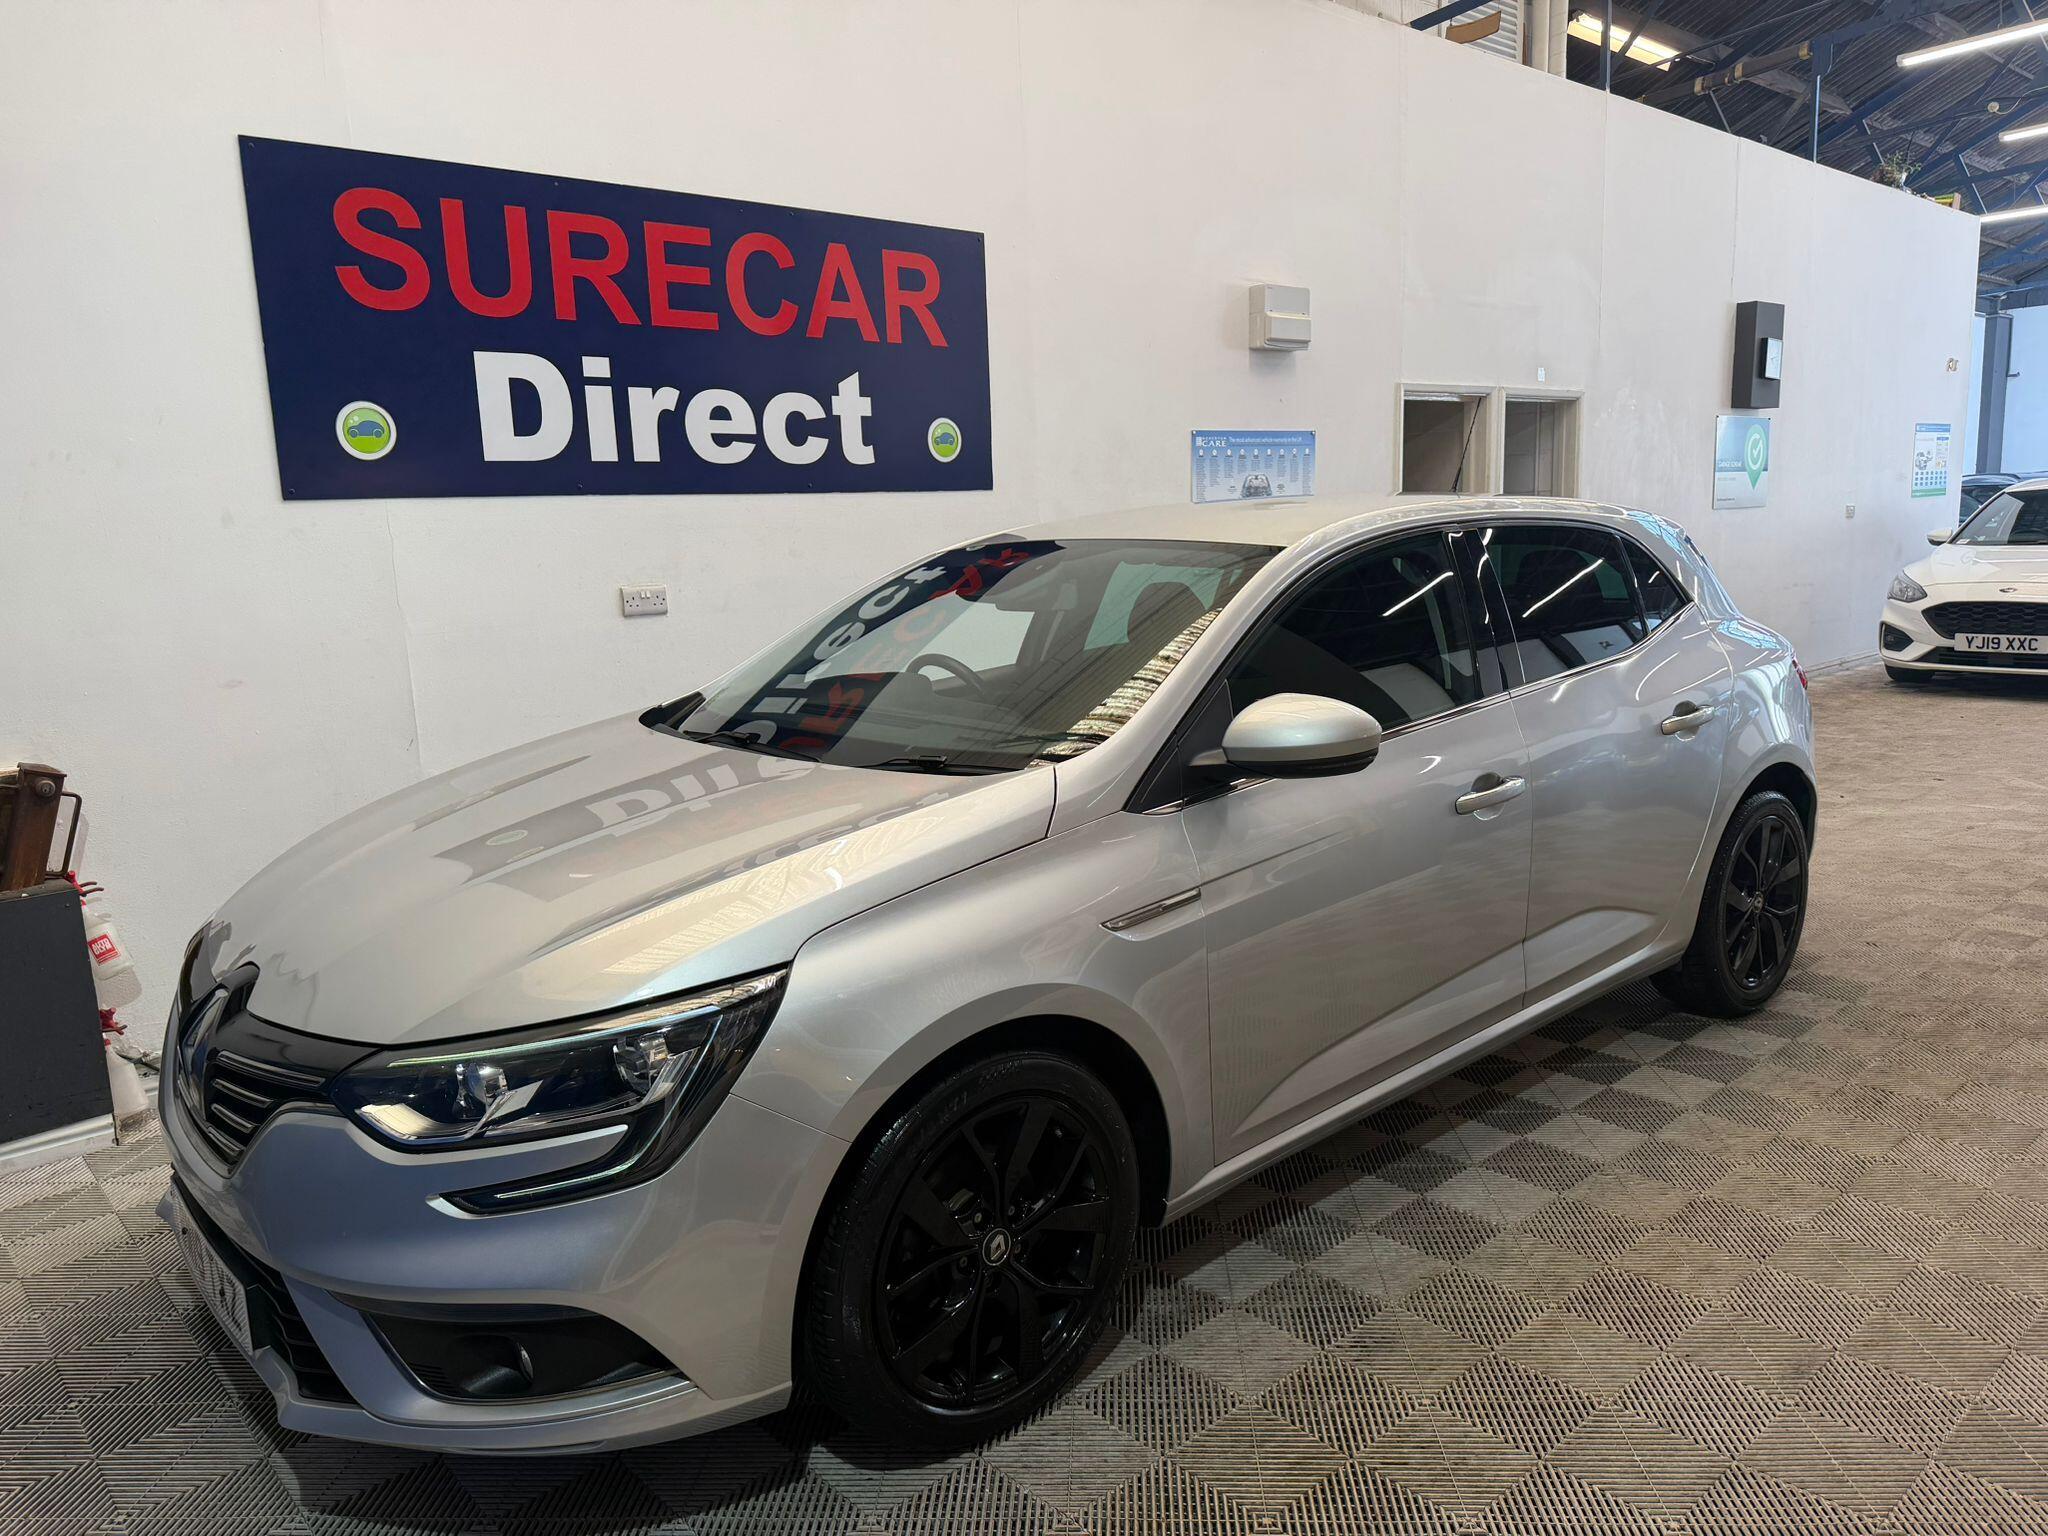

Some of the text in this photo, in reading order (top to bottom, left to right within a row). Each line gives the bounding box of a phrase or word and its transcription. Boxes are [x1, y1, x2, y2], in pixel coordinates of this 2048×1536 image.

[332, 187, 948, 347] SURECAR
[473, 351, 875, 466] Direct
[1965, 635, 2039, 651] YJ19 XXC
